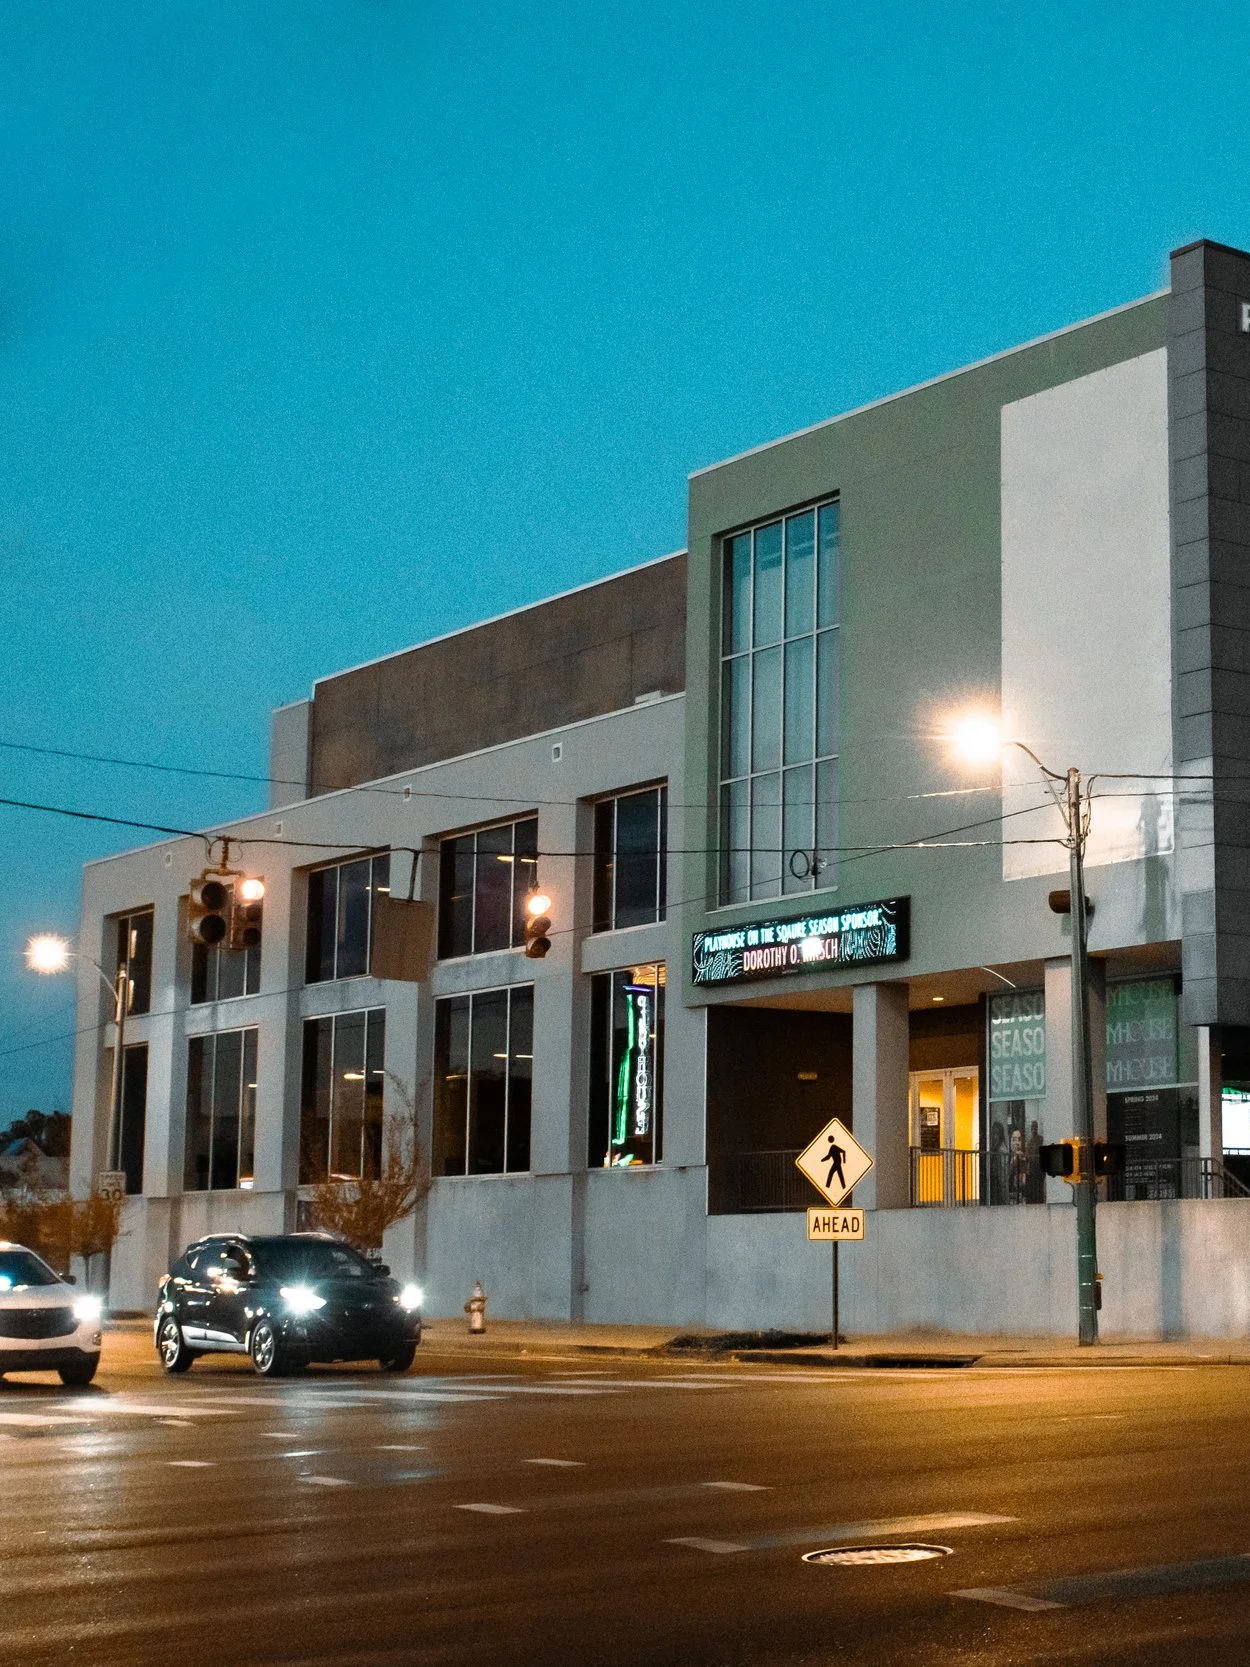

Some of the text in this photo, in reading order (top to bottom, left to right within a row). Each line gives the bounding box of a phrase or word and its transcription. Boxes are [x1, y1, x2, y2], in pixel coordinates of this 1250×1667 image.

[704, 931, 746, 953] PLAYHOUSE
[748, 930, 759, 946] ON
[761, 927, 775, 944] THE
[808, 916, 839, 936] SEASON
[743, 937, 838, 972] DOROTHY O. SCH
[992, 993, 1044, 1025] SEASO
[991, 1026, 1045, 1059] SEASO
[991, 1061, 1045, 1094] SEASO
[102, 1188, 122, 1201] 30
[812, 1216, 860, 1233] AHEAD
